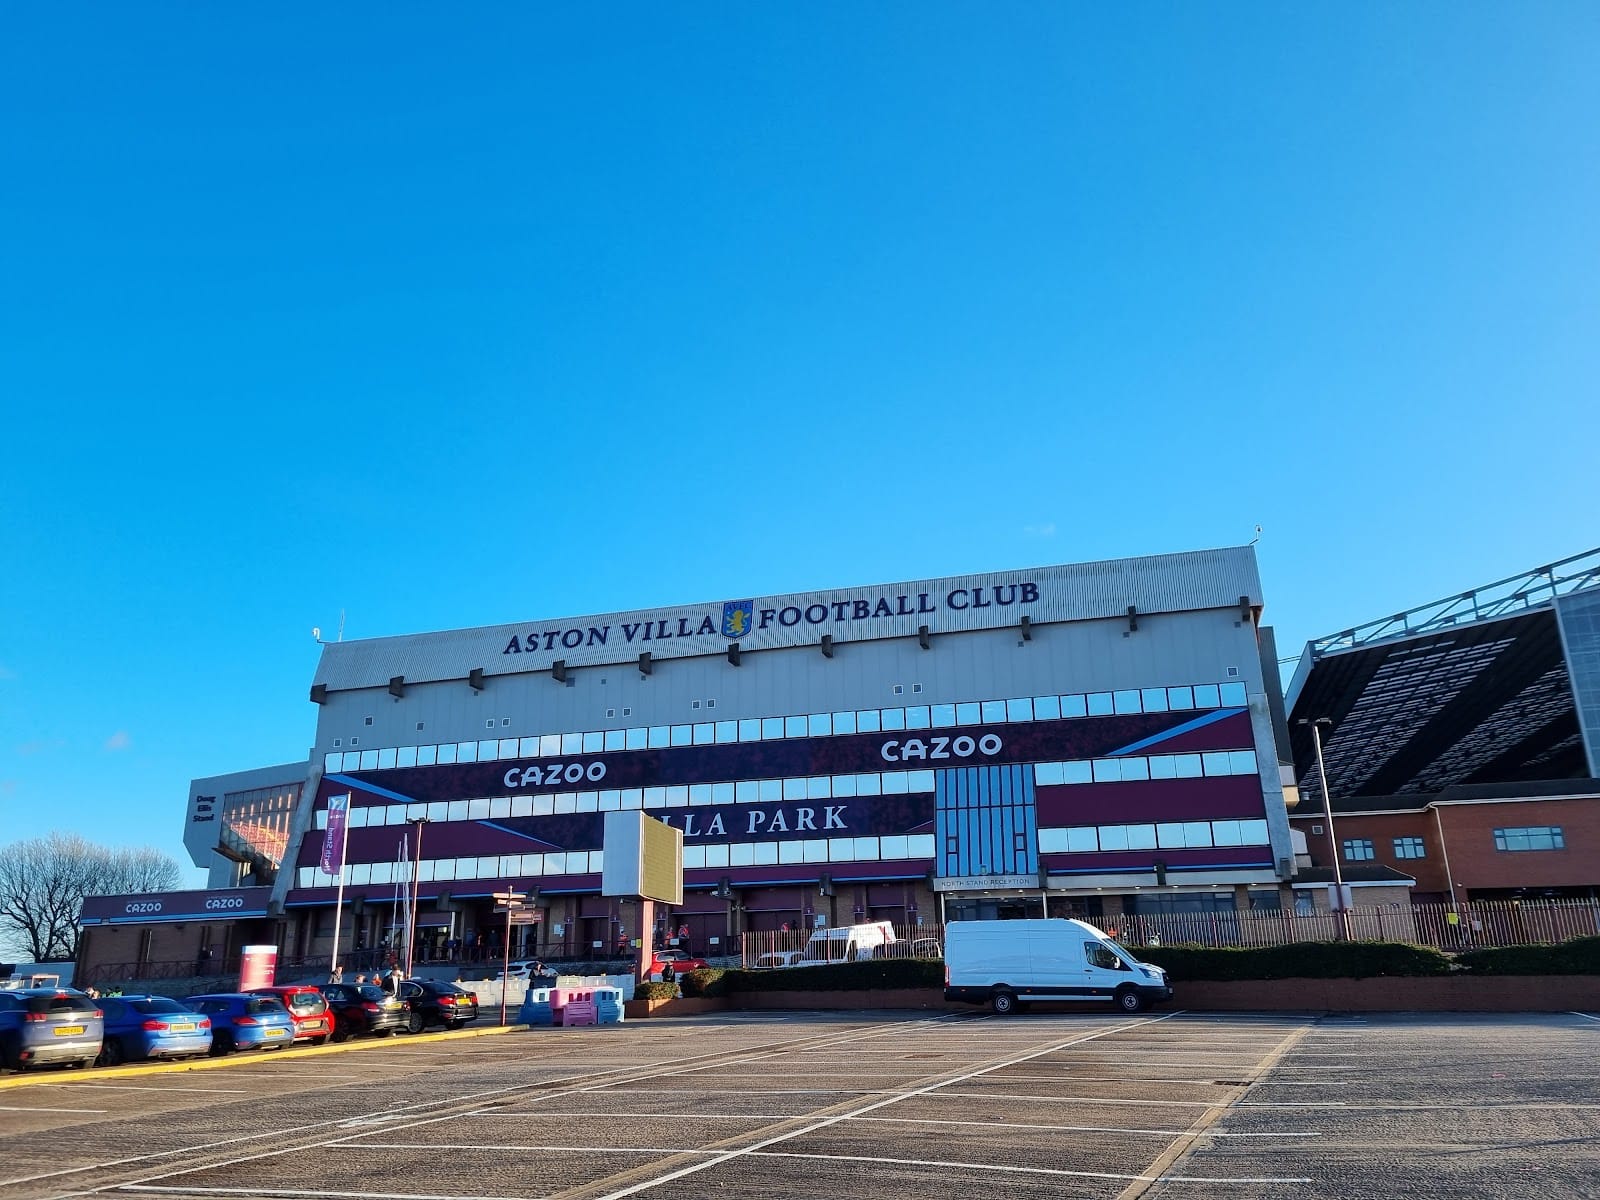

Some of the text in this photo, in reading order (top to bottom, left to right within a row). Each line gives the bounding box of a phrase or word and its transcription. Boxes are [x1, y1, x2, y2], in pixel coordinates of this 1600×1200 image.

[503, 582, 1040, 654] ASTON VILLA FOOTBALL CLUB
[881, 734, 1003, 761] CAZOO
[503, 761, 607, 788] CAZOO
[746, 805, 848, 834] PARK
[125, 902, 162, 913] CAZOO
[205, 898, 244, 909] CAZOO
